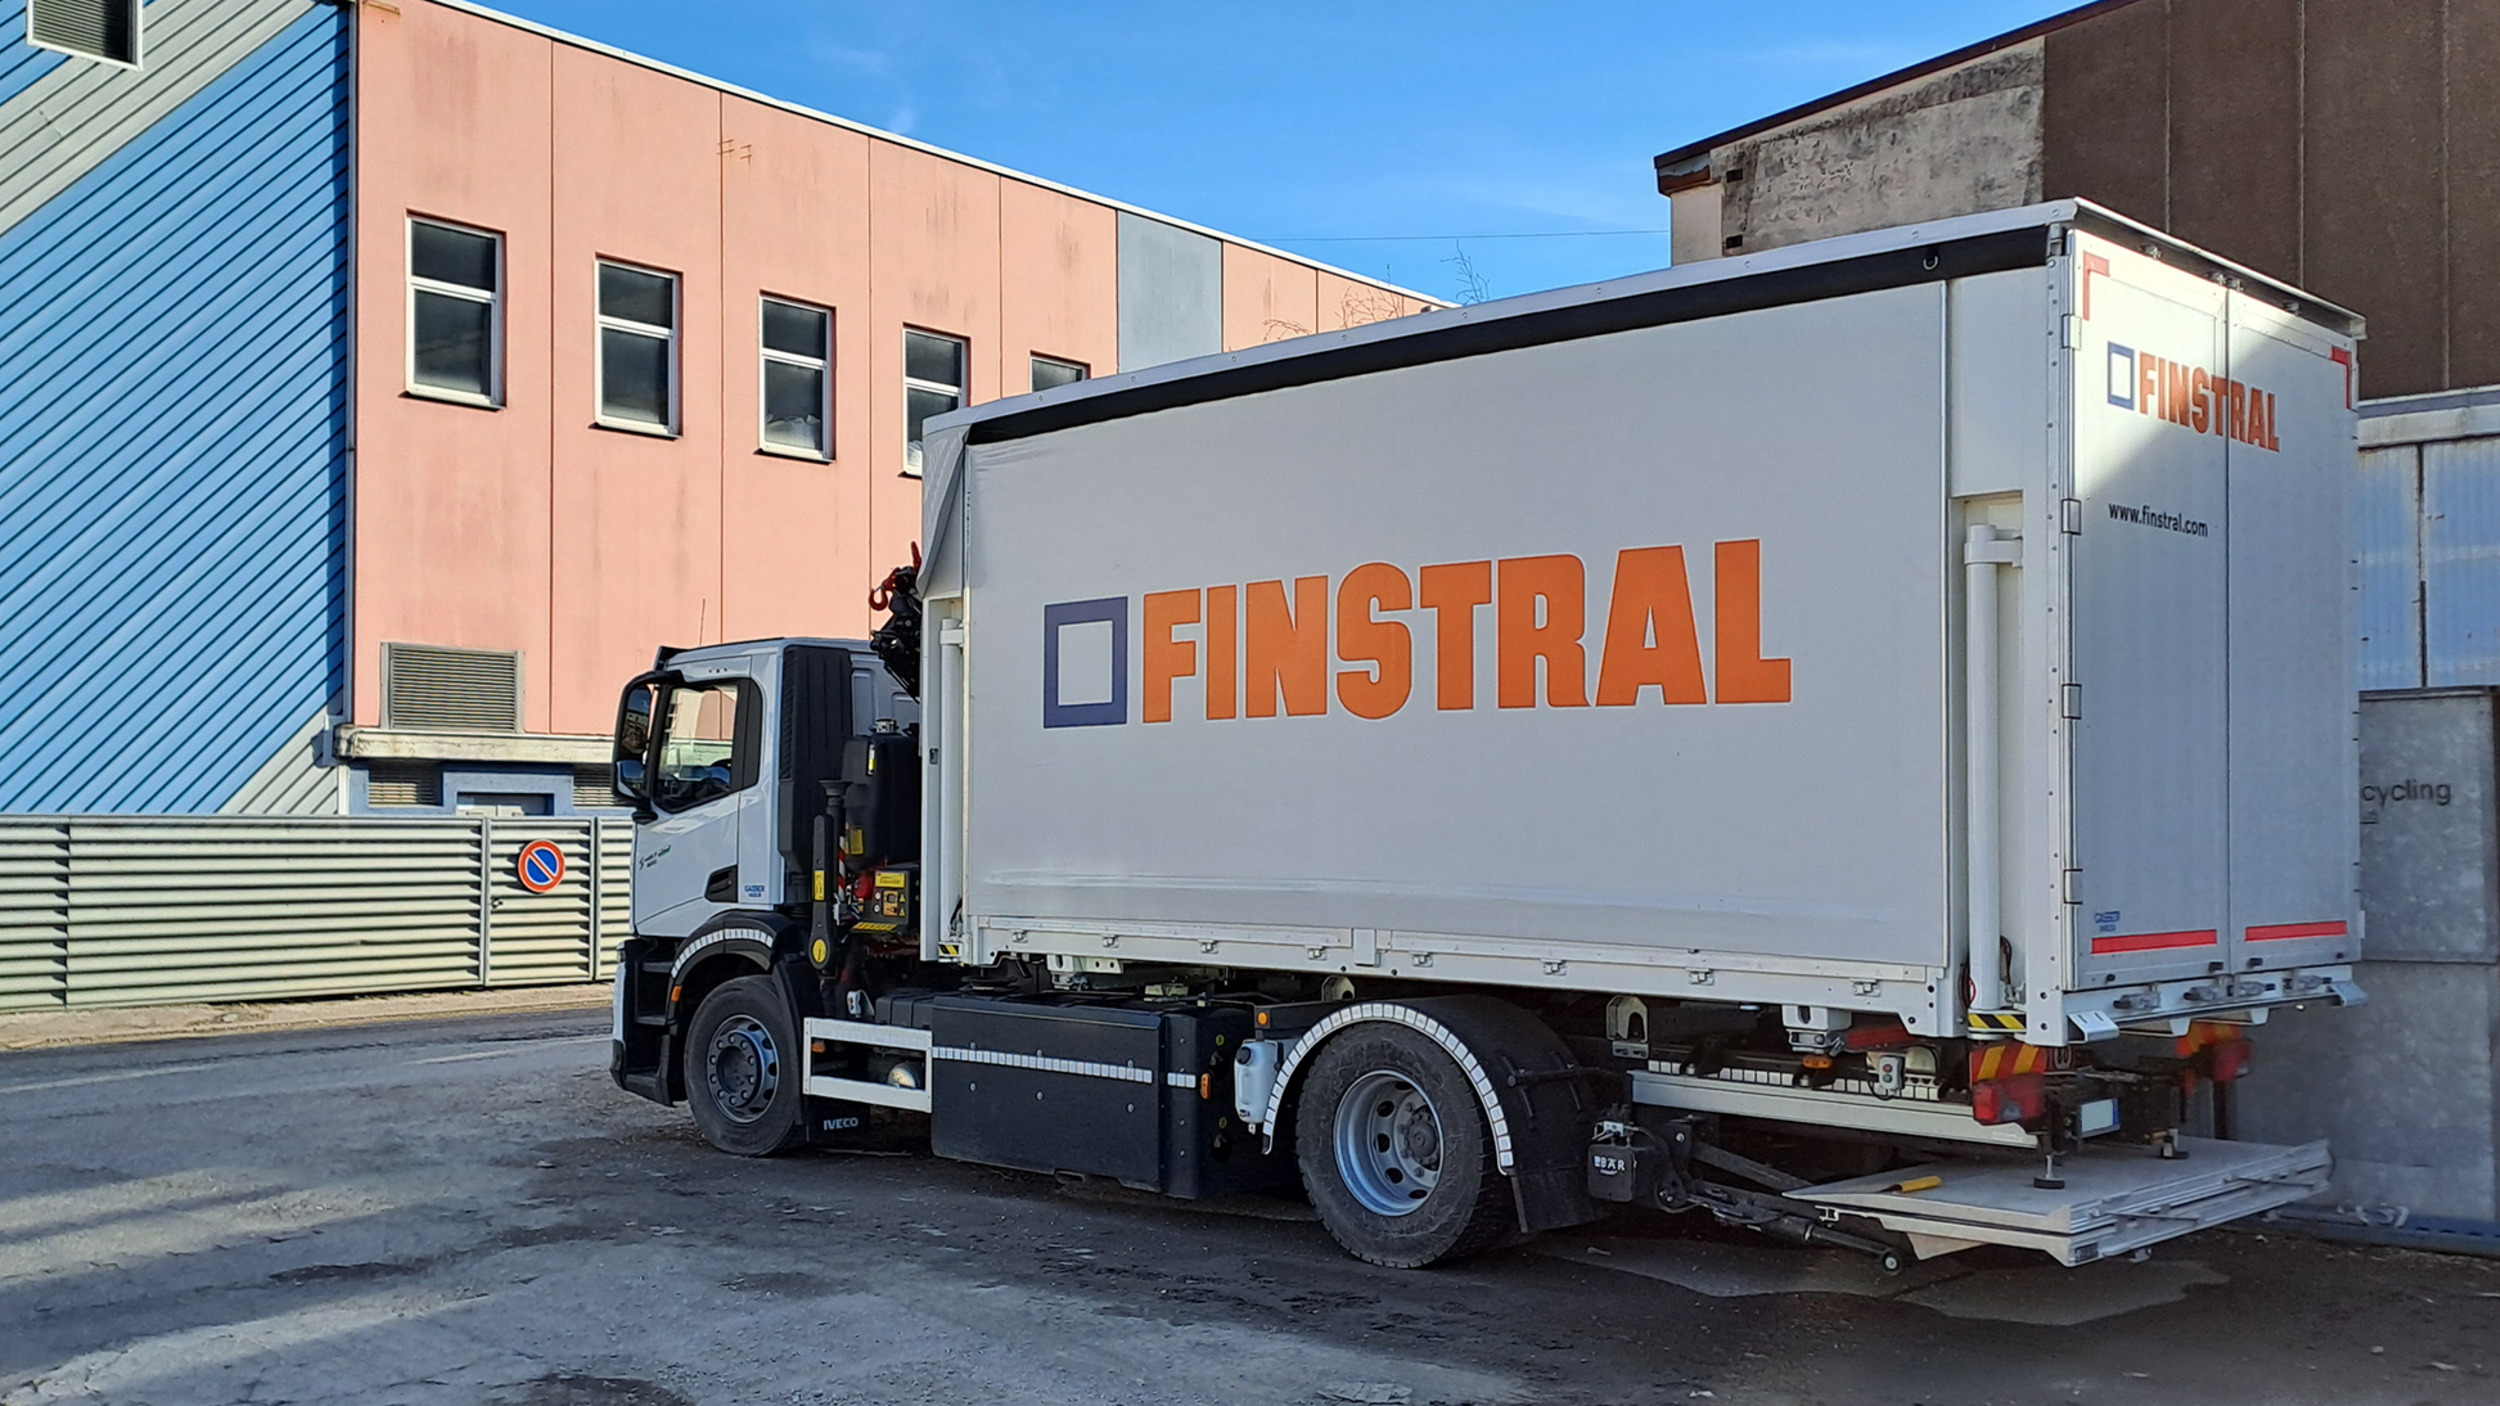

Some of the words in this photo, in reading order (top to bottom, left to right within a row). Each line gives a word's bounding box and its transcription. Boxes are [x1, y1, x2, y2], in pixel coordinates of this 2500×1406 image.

[2139, 351, 2280, 453] FINSTRAL
[2108, 502, 2208, 537] www.finstral.com
[1143, 539, 1792, 723] FINSTRAL
[2362, 779, 2451, 808] cycling
[823, 1117, 859, 1130] IVECO
